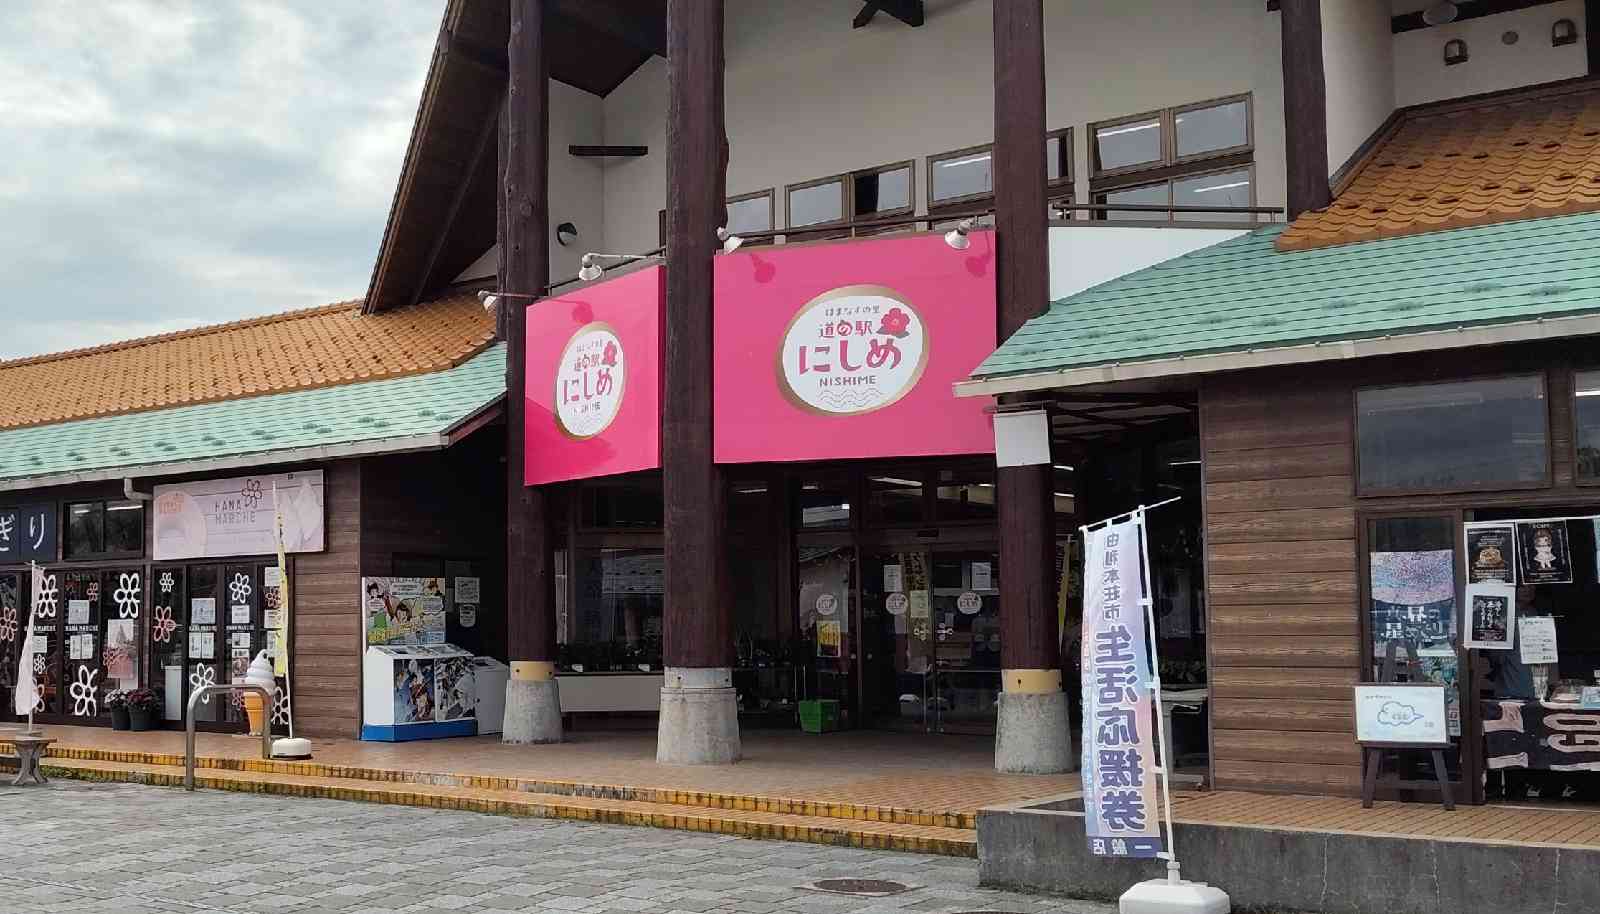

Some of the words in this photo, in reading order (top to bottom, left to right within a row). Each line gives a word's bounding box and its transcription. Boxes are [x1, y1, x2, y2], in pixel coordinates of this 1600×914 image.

[819, 320, 873, 338] 道の駅
[799, 338, 902, 375] にしめ
[563, 368, 613, 405] にしめ
[819, 375, 876, 387] NISHIME
[215, 498, 241, 512] HANA
